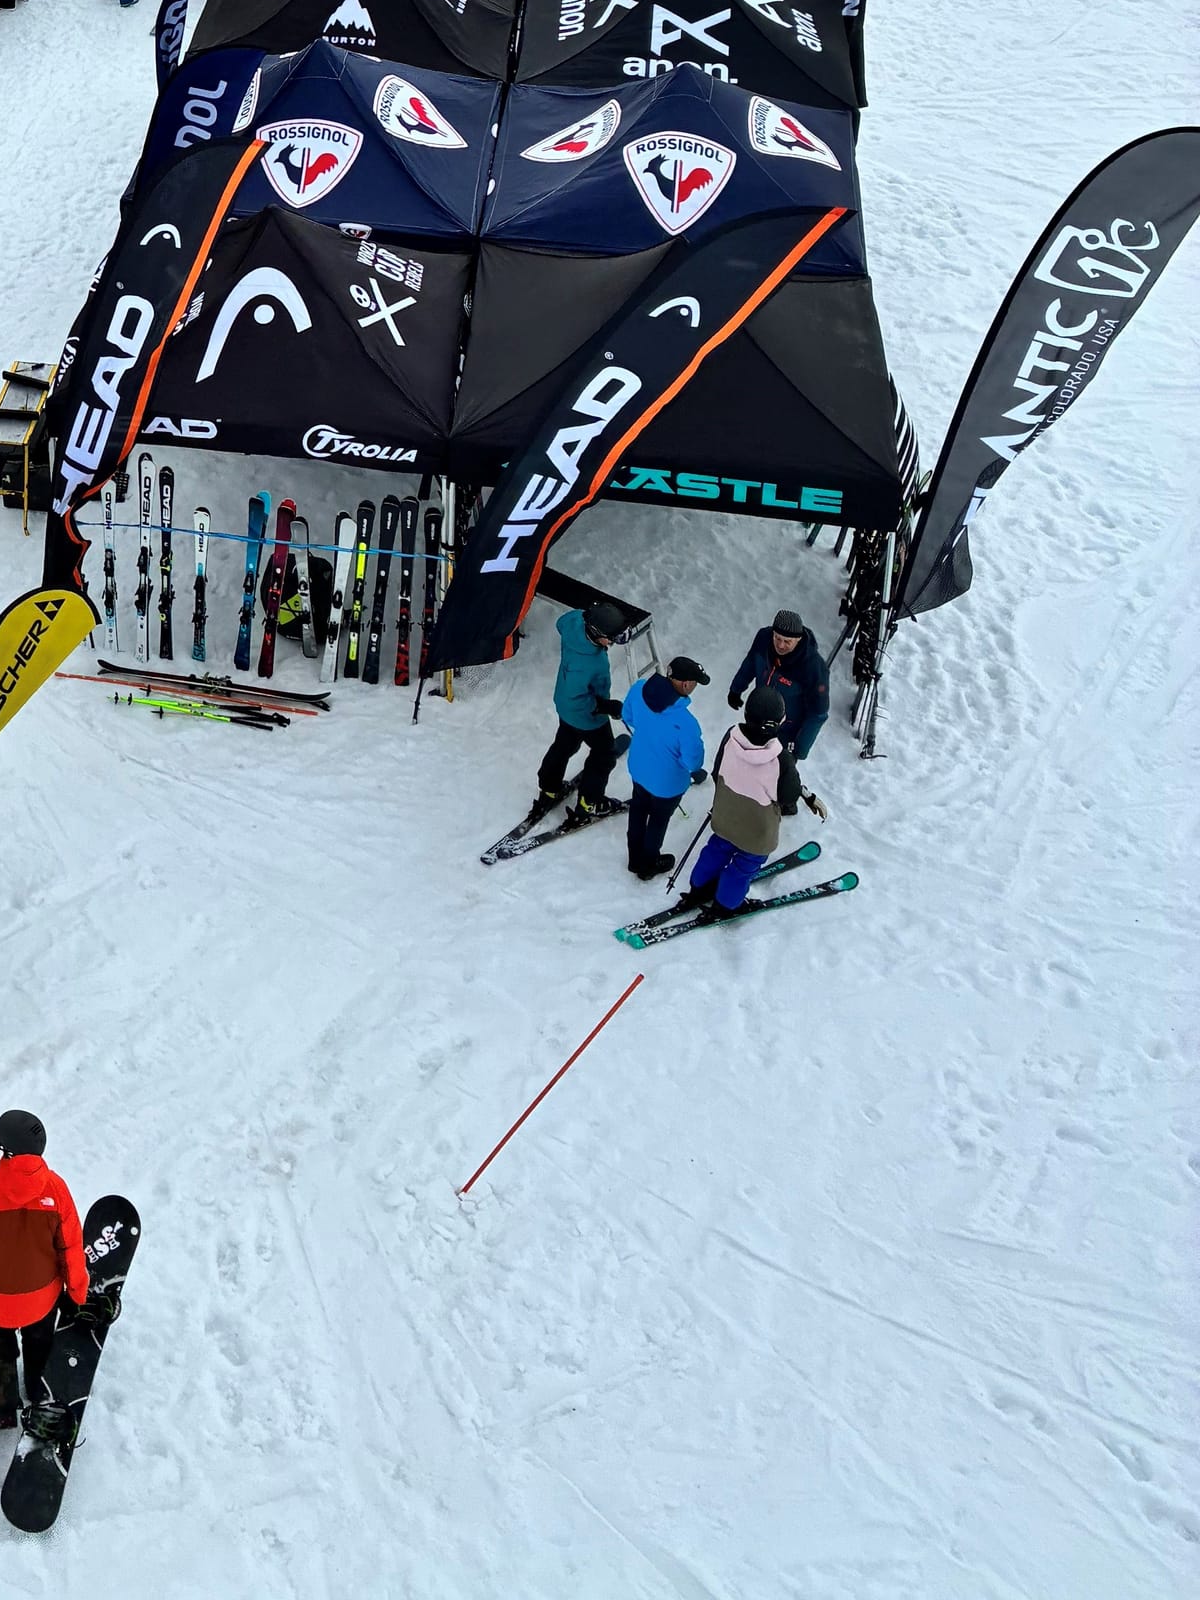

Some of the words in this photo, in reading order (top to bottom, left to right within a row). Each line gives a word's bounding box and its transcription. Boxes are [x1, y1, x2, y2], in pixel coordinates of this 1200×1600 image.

[268, 126, 349, 147] ROSSIGNOL
[635, 139, 724, 164] ROSSIGNOL
[1091, 318, 1120, 346] USA
[306, 425, 418, 463] TYROLIA
[480, 366, 642, 573] HEAD
[105, 492, 113, 529] HEAD
[143, 475, 152, 526] HEAD
